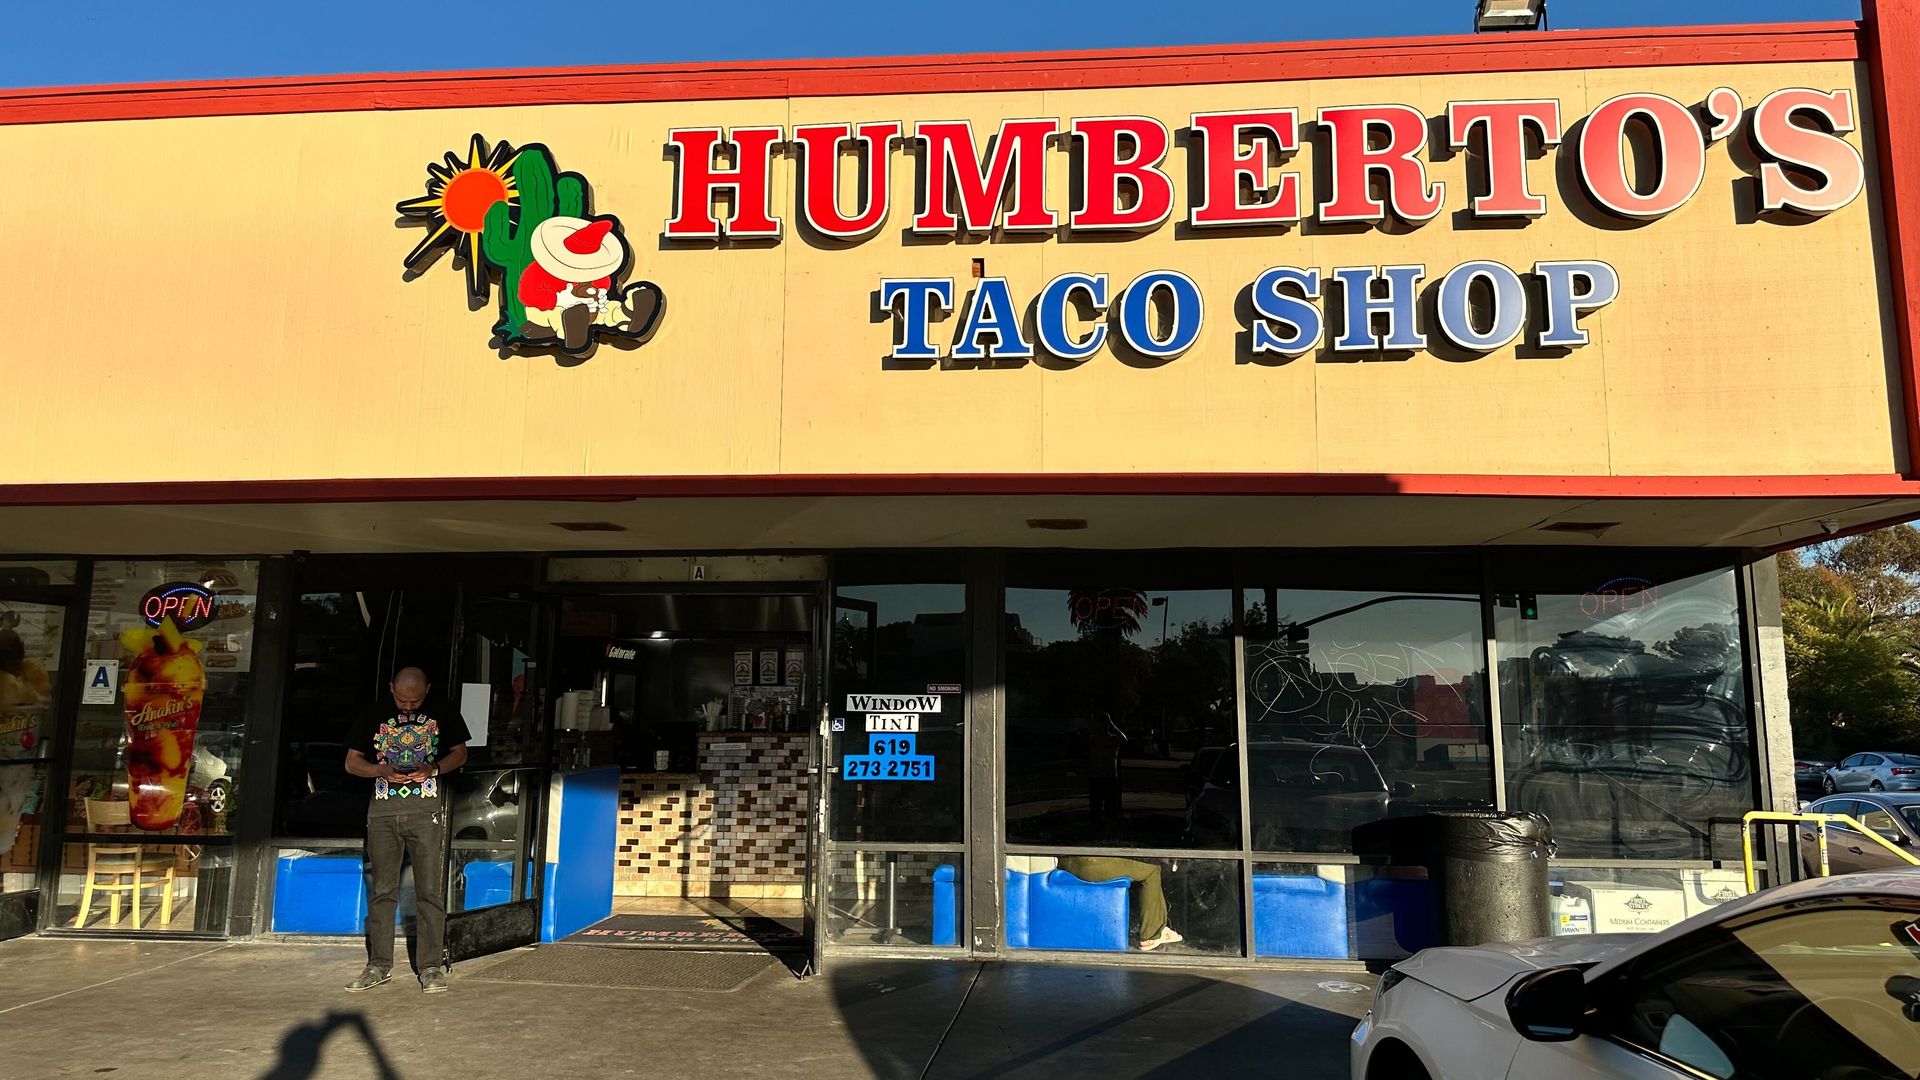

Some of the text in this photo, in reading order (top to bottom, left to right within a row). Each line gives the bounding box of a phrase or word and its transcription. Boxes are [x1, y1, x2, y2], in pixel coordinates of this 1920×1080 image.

[665, 86, 1866, 239] HUMBERTO'S
[880, 260, 1620, 361] TACO SHOP
[695, 566, 704, 579] A
[1580, 584, 1658, 615] OPEN
[91, 666, 110, 688] A
[131, 695, 193, 726] Anakin's
[850, 695, 938, 711] WINDOW
[870, 715, 915, 730] TINT
[874, 739, 910, 756] 619
